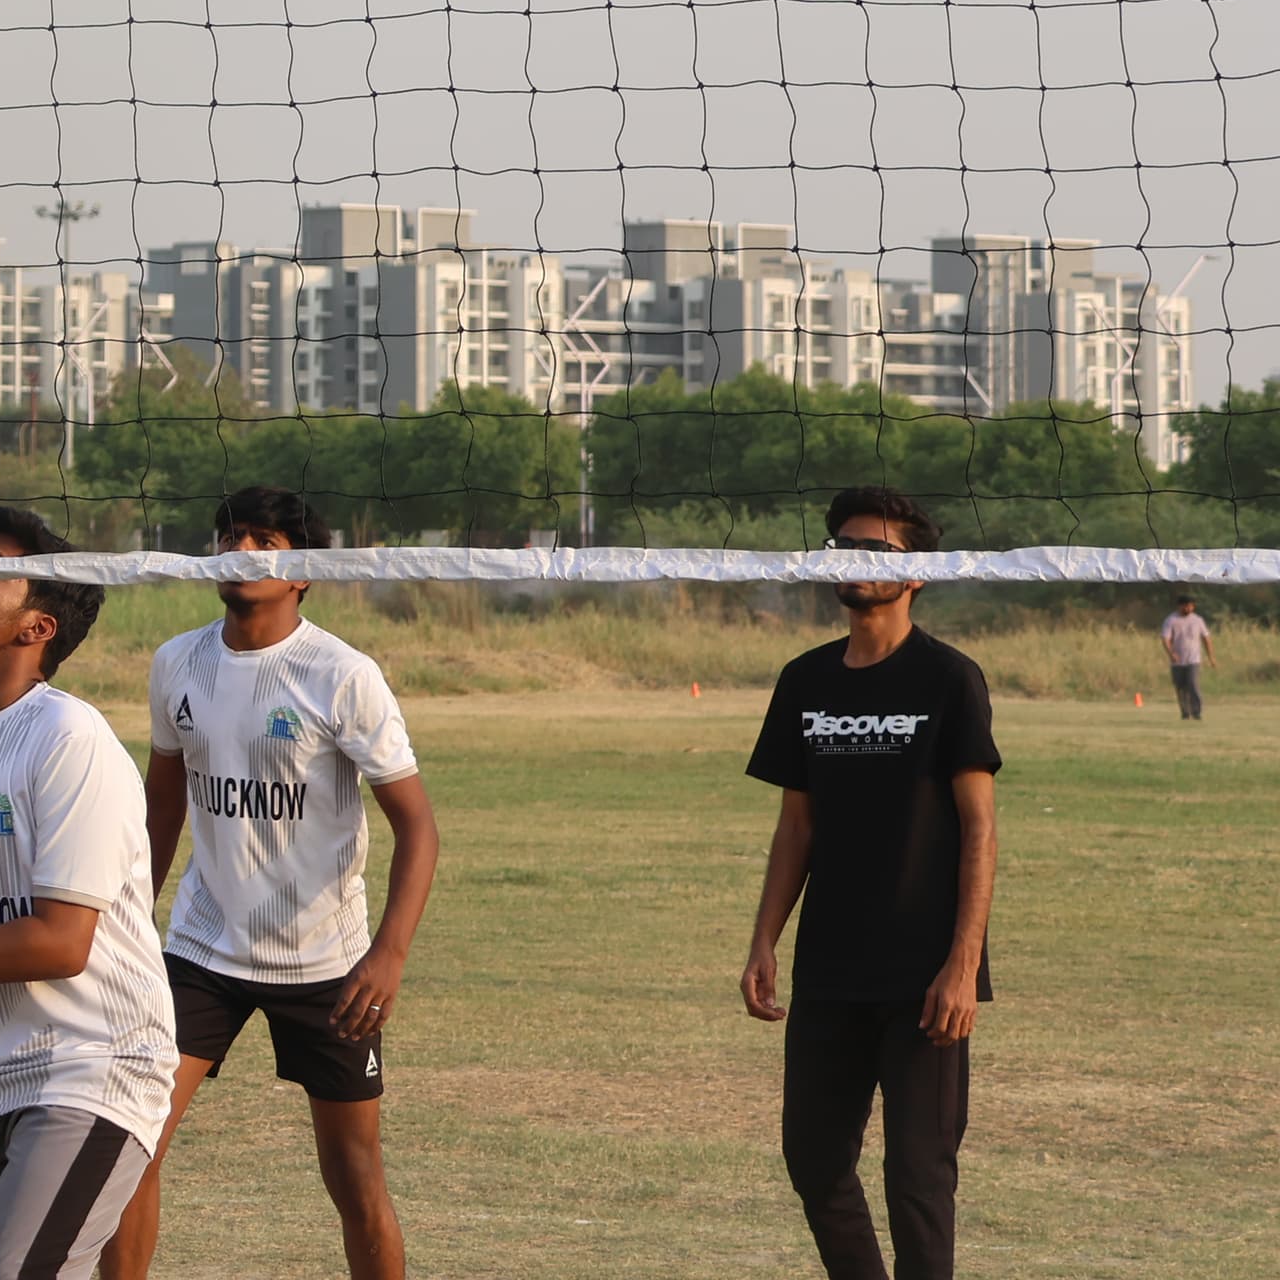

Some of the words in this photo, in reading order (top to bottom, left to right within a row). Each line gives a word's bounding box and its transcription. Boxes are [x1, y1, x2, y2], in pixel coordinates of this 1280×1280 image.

[808, 736, 834, 745] THE
[850, 734, 912, 744] WORLD
[203, 774, 307, 821] LUCKNOW
